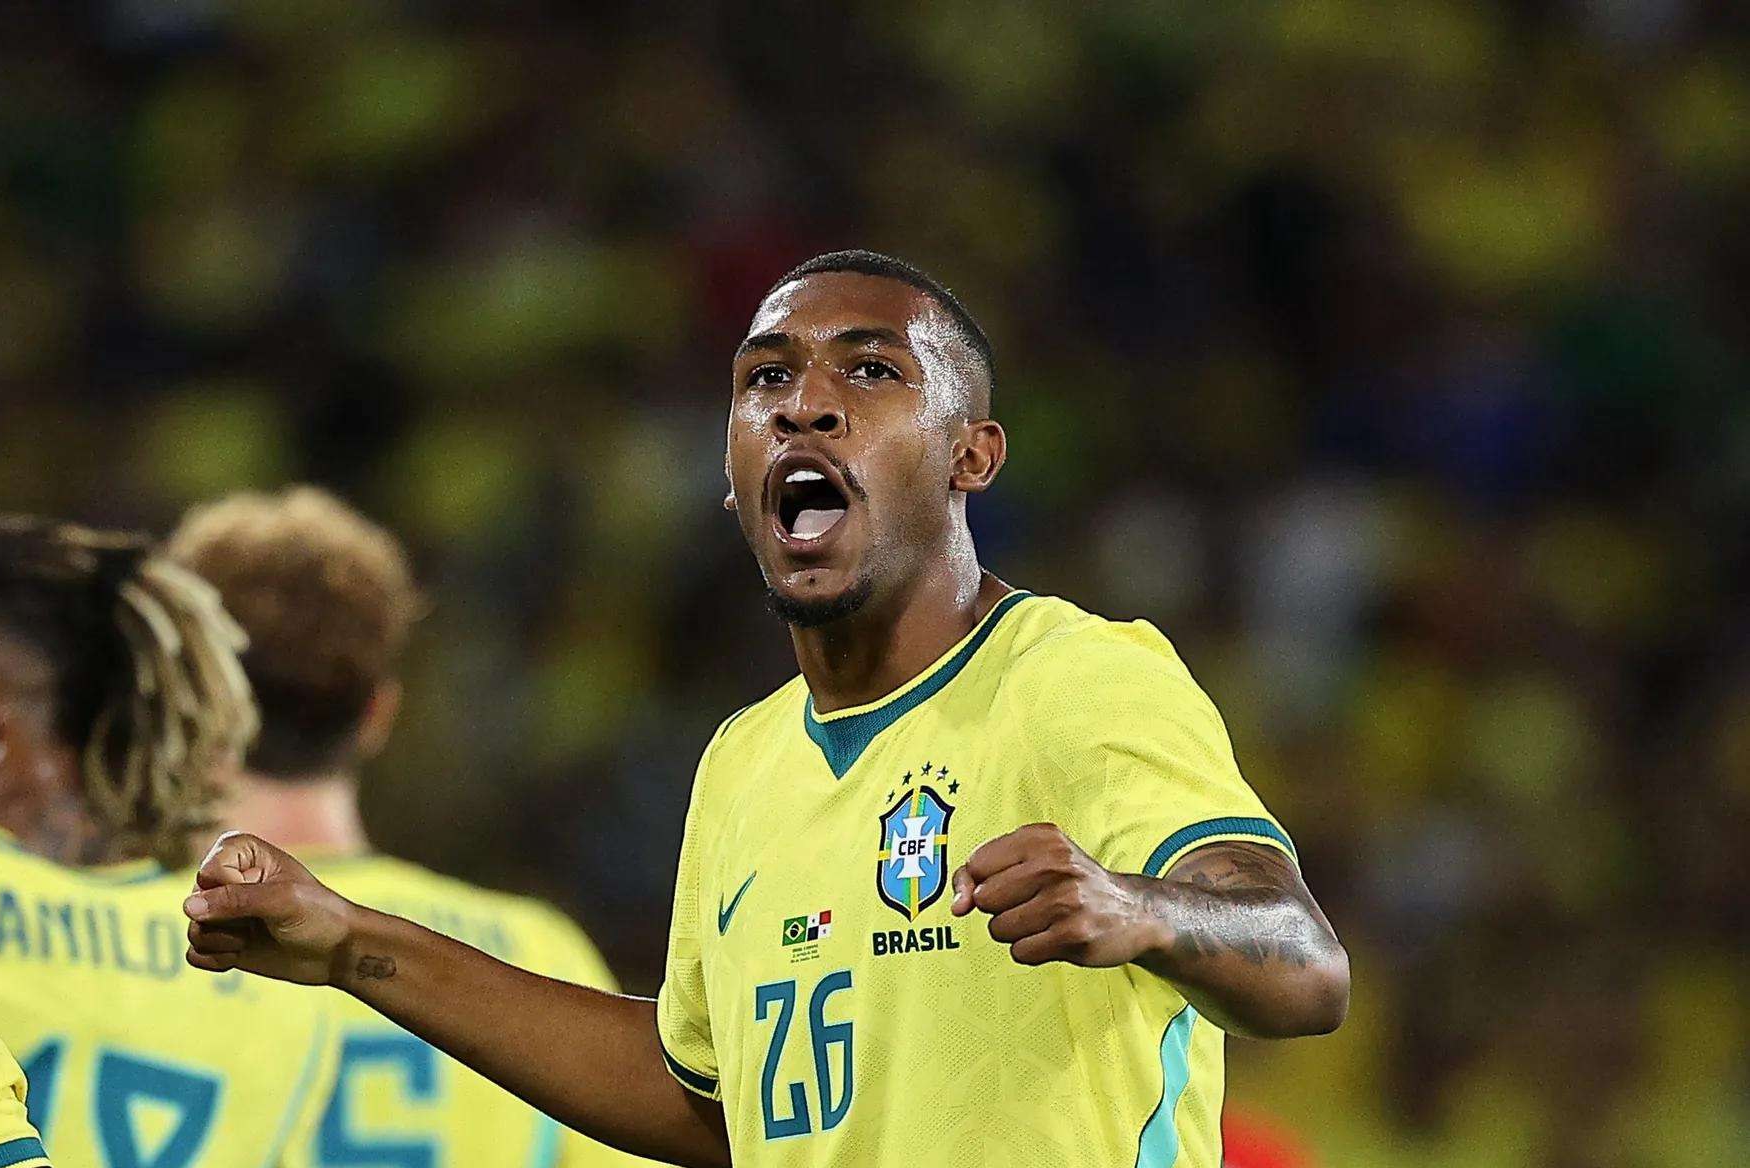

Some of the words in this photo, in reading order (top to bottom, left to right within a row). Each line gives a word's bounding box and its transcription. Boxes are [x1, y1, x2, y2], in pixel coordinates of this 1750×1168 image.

[898, 838, 927, 856] CBF
[872, 925, 960, 956] BRASIL
[754, 968, 854, 1142] 26
